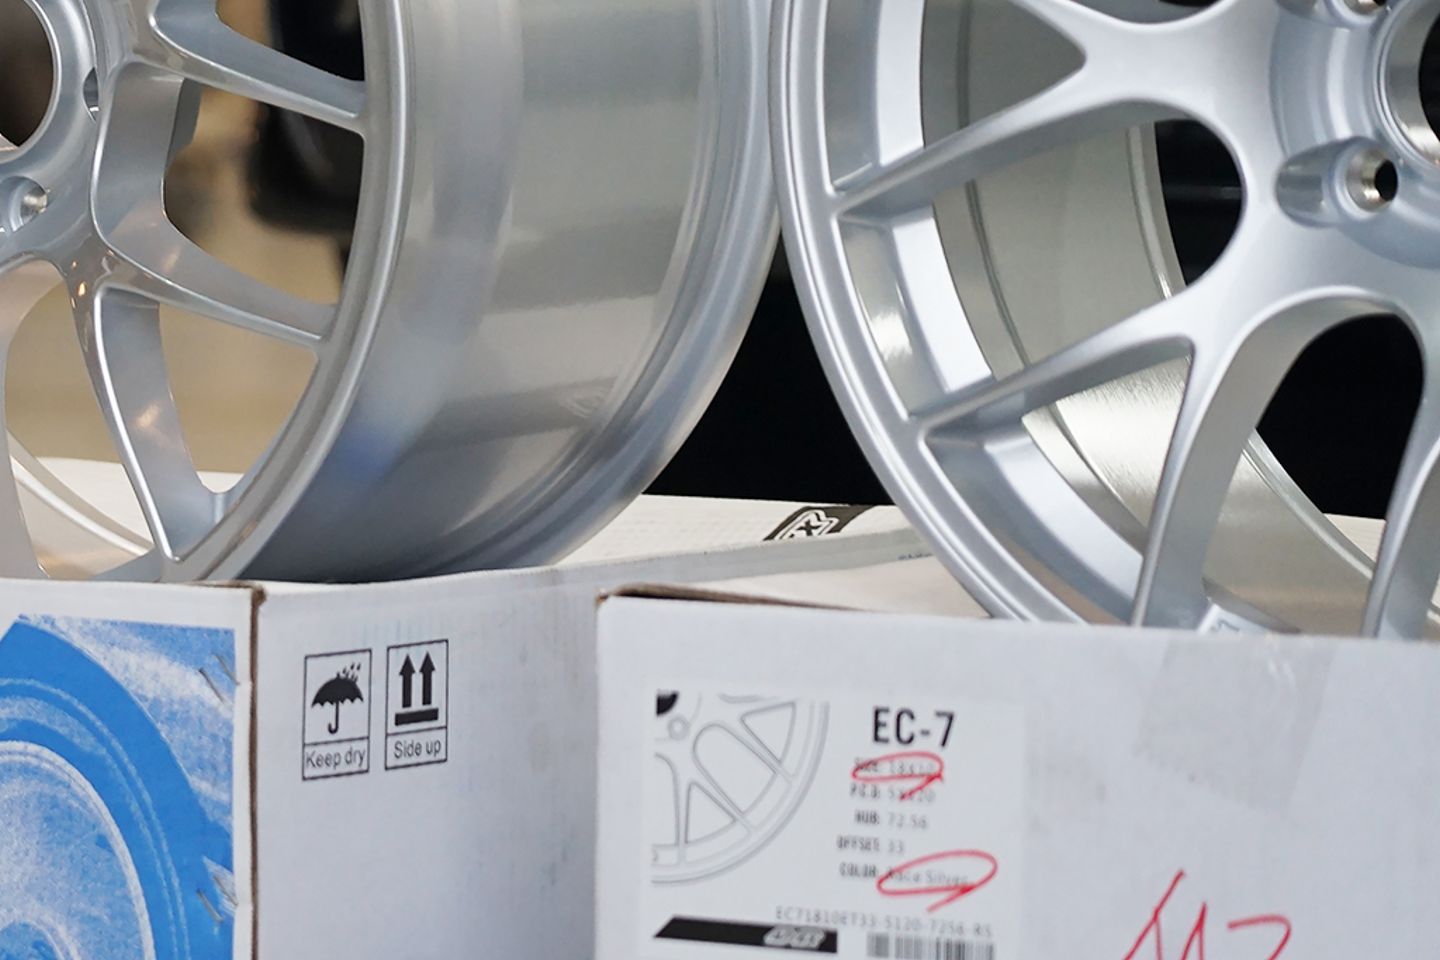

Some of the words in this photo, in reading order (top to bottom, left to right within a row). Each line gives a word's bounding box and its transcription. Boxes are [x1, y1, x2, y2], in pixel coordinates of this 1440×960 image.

[873, 705, 955, 748] EC-7
[305, 749, 341, 769] Keep
[344, 745, 366, 767] dry
[394, 739, 422, 759] Side
[425, 739, 442, 757] up
